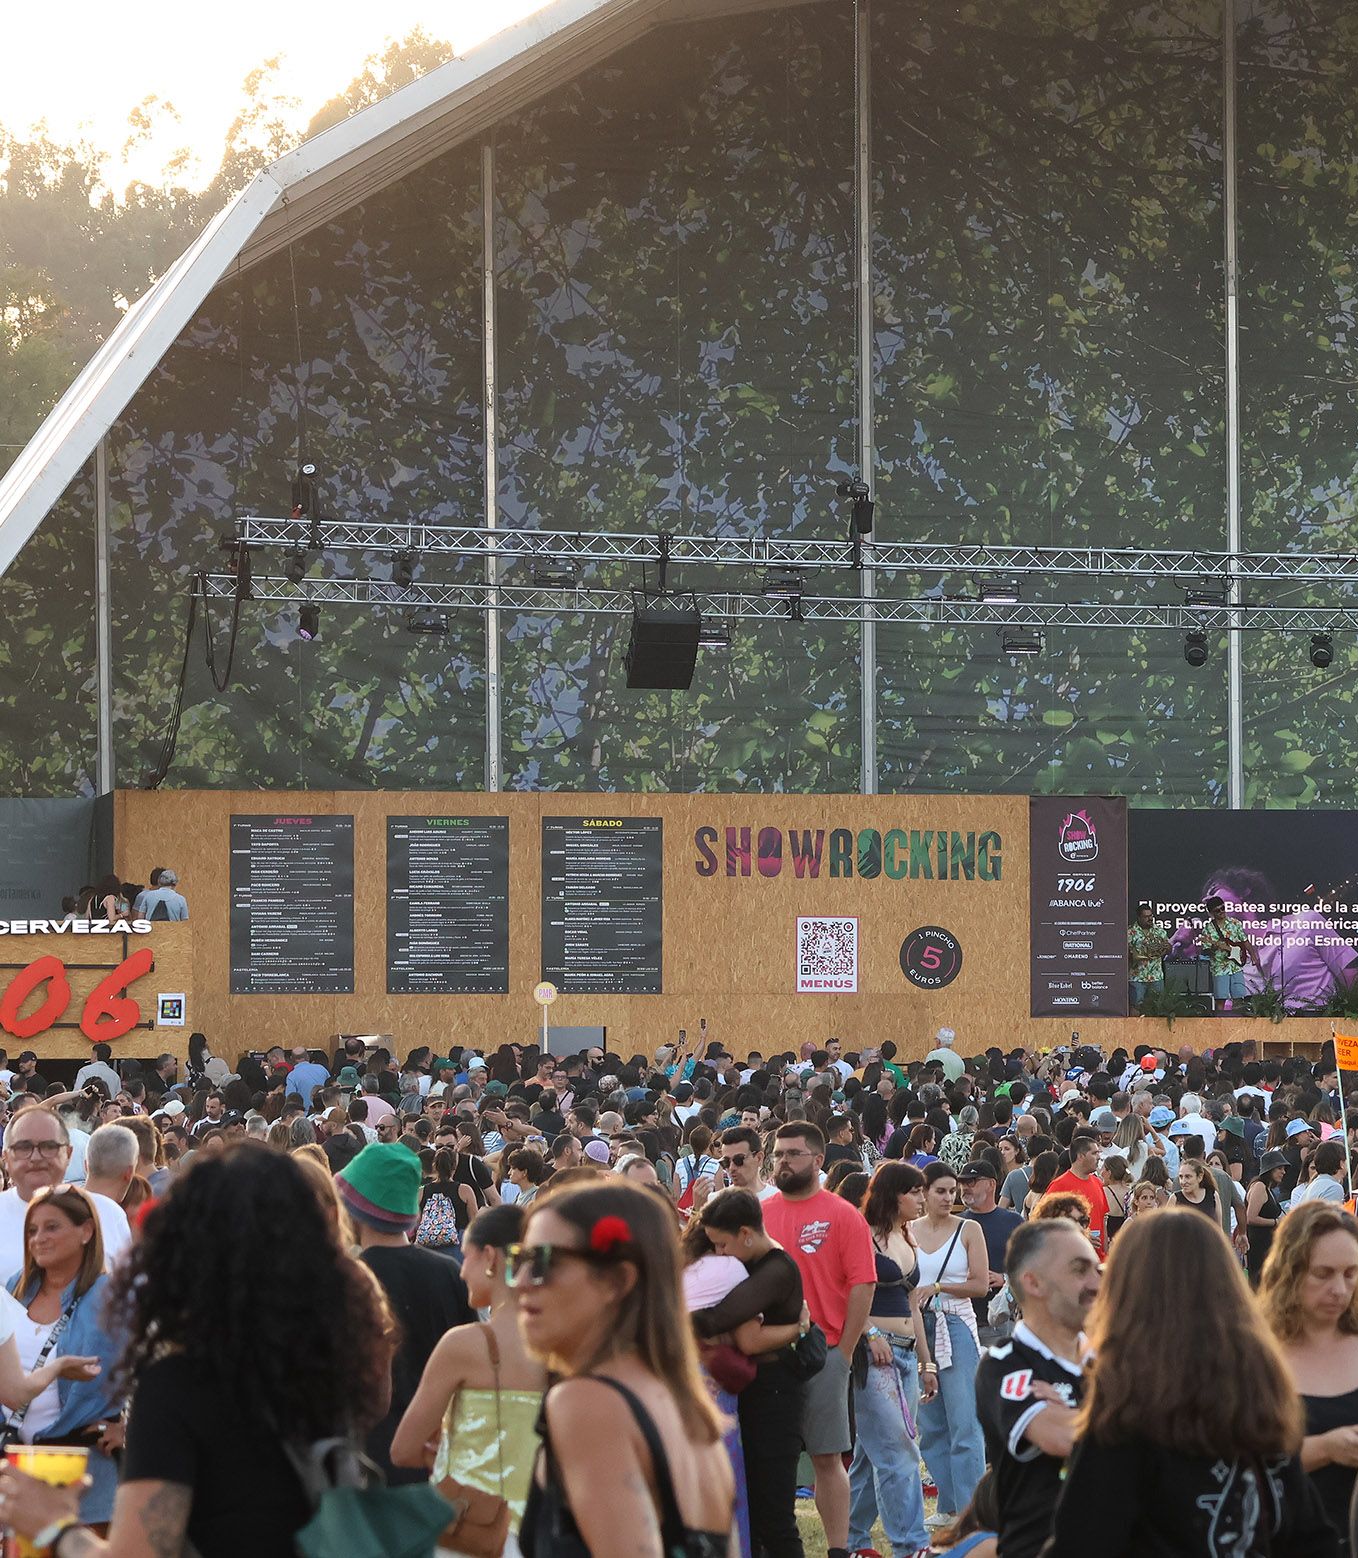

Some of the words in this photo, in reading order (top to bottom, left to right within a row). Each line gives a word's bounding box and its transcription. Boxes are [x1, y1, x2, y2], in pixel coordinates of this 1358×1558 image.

[582, 819, 623, 827] SÁBADO
[1066, 830, 1086, 841] SHOW
[1063, 839, 1093, 853] ROCKING
[1057, 878, 1095, 893] 1906
[1224, 901, 1267, 913] Batea
[1269, 903, 1310, 916] surge
[1313, 901, 1332, 913] de
[1335, 901, 1348, 913] la
[1175, 918, 1268, 929] Fundnes
[1271, 917, 1358, 930] Portamérica
[924, 930, 955, 950] PINCHO
[1286, 937, 1311, 948] por
[919, 945, 944, 970] 5
[801, 977, 853, 988] MENÚS
[908, 968, 942, 985] EUROS
[538, 989, 553, 999] PMR
